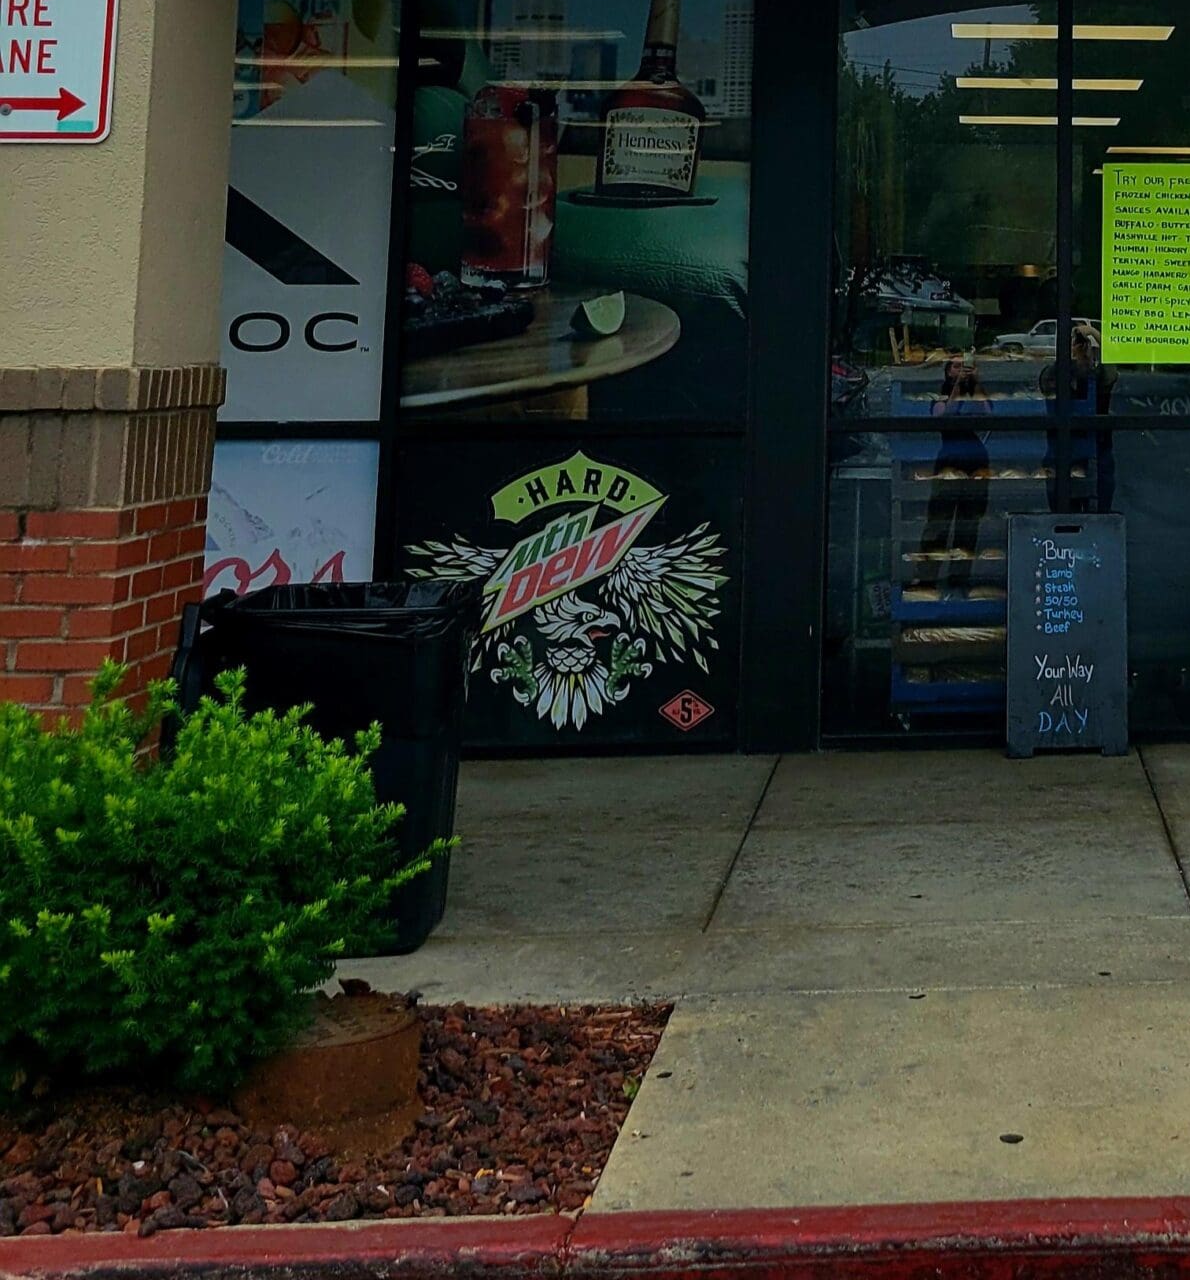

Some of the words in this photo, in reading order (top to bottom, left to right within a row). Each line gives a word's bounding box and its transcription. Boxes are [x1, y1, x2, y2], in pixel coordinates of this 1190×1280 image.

[1144, 176, 1164, 186] OUR
[1114, 191, 1150, 200] FROZEN
[1155, 192, 1190, 200] CHICKEN
[1115, 206, 1151, 214] SAUCES
[1114, 219, 1154, 229] BUFFALO
[1113, 231, 1158, 241] NASHVILLE
[1113, 245, 1149, 253] MUMBAI
[1155, 246, 1187, 254] HICKORY
[1112, 256, 1155, 266] TERIYAKI
[1143, 270, 1187, 279] HABANERO
[1112, 281, 1143, 289] GARLIC
[1145, 282, 1171, 292] PARM
[1112, 294, 1130, 302] HOT
[1139, 295, 1158, 304] HOT
[1165, 297, 1190, 308] SPICY
[1111, 308, 1140, 317] HONEY
[1144, 309, 1164, 318] BBQ
[1110, 321, 1136, 330] MILD
[1143, 322, 1190, 332] JAMAICAN
[1145, 336, 1189, 345] BOURBON
[524, 468, 630, 506] HARD
[1045, 568, 1072, 579] Lamb
[1044, 596, 1078, 606] 50/50
[1043, 608, 1083, 623] Turkey
[1044, 621, 1071, 633] Beef
[1034, 654, 1065, 680] Your
[1065, 654, 1094, 683] Way
[1050, 685, 1074, 706] All
